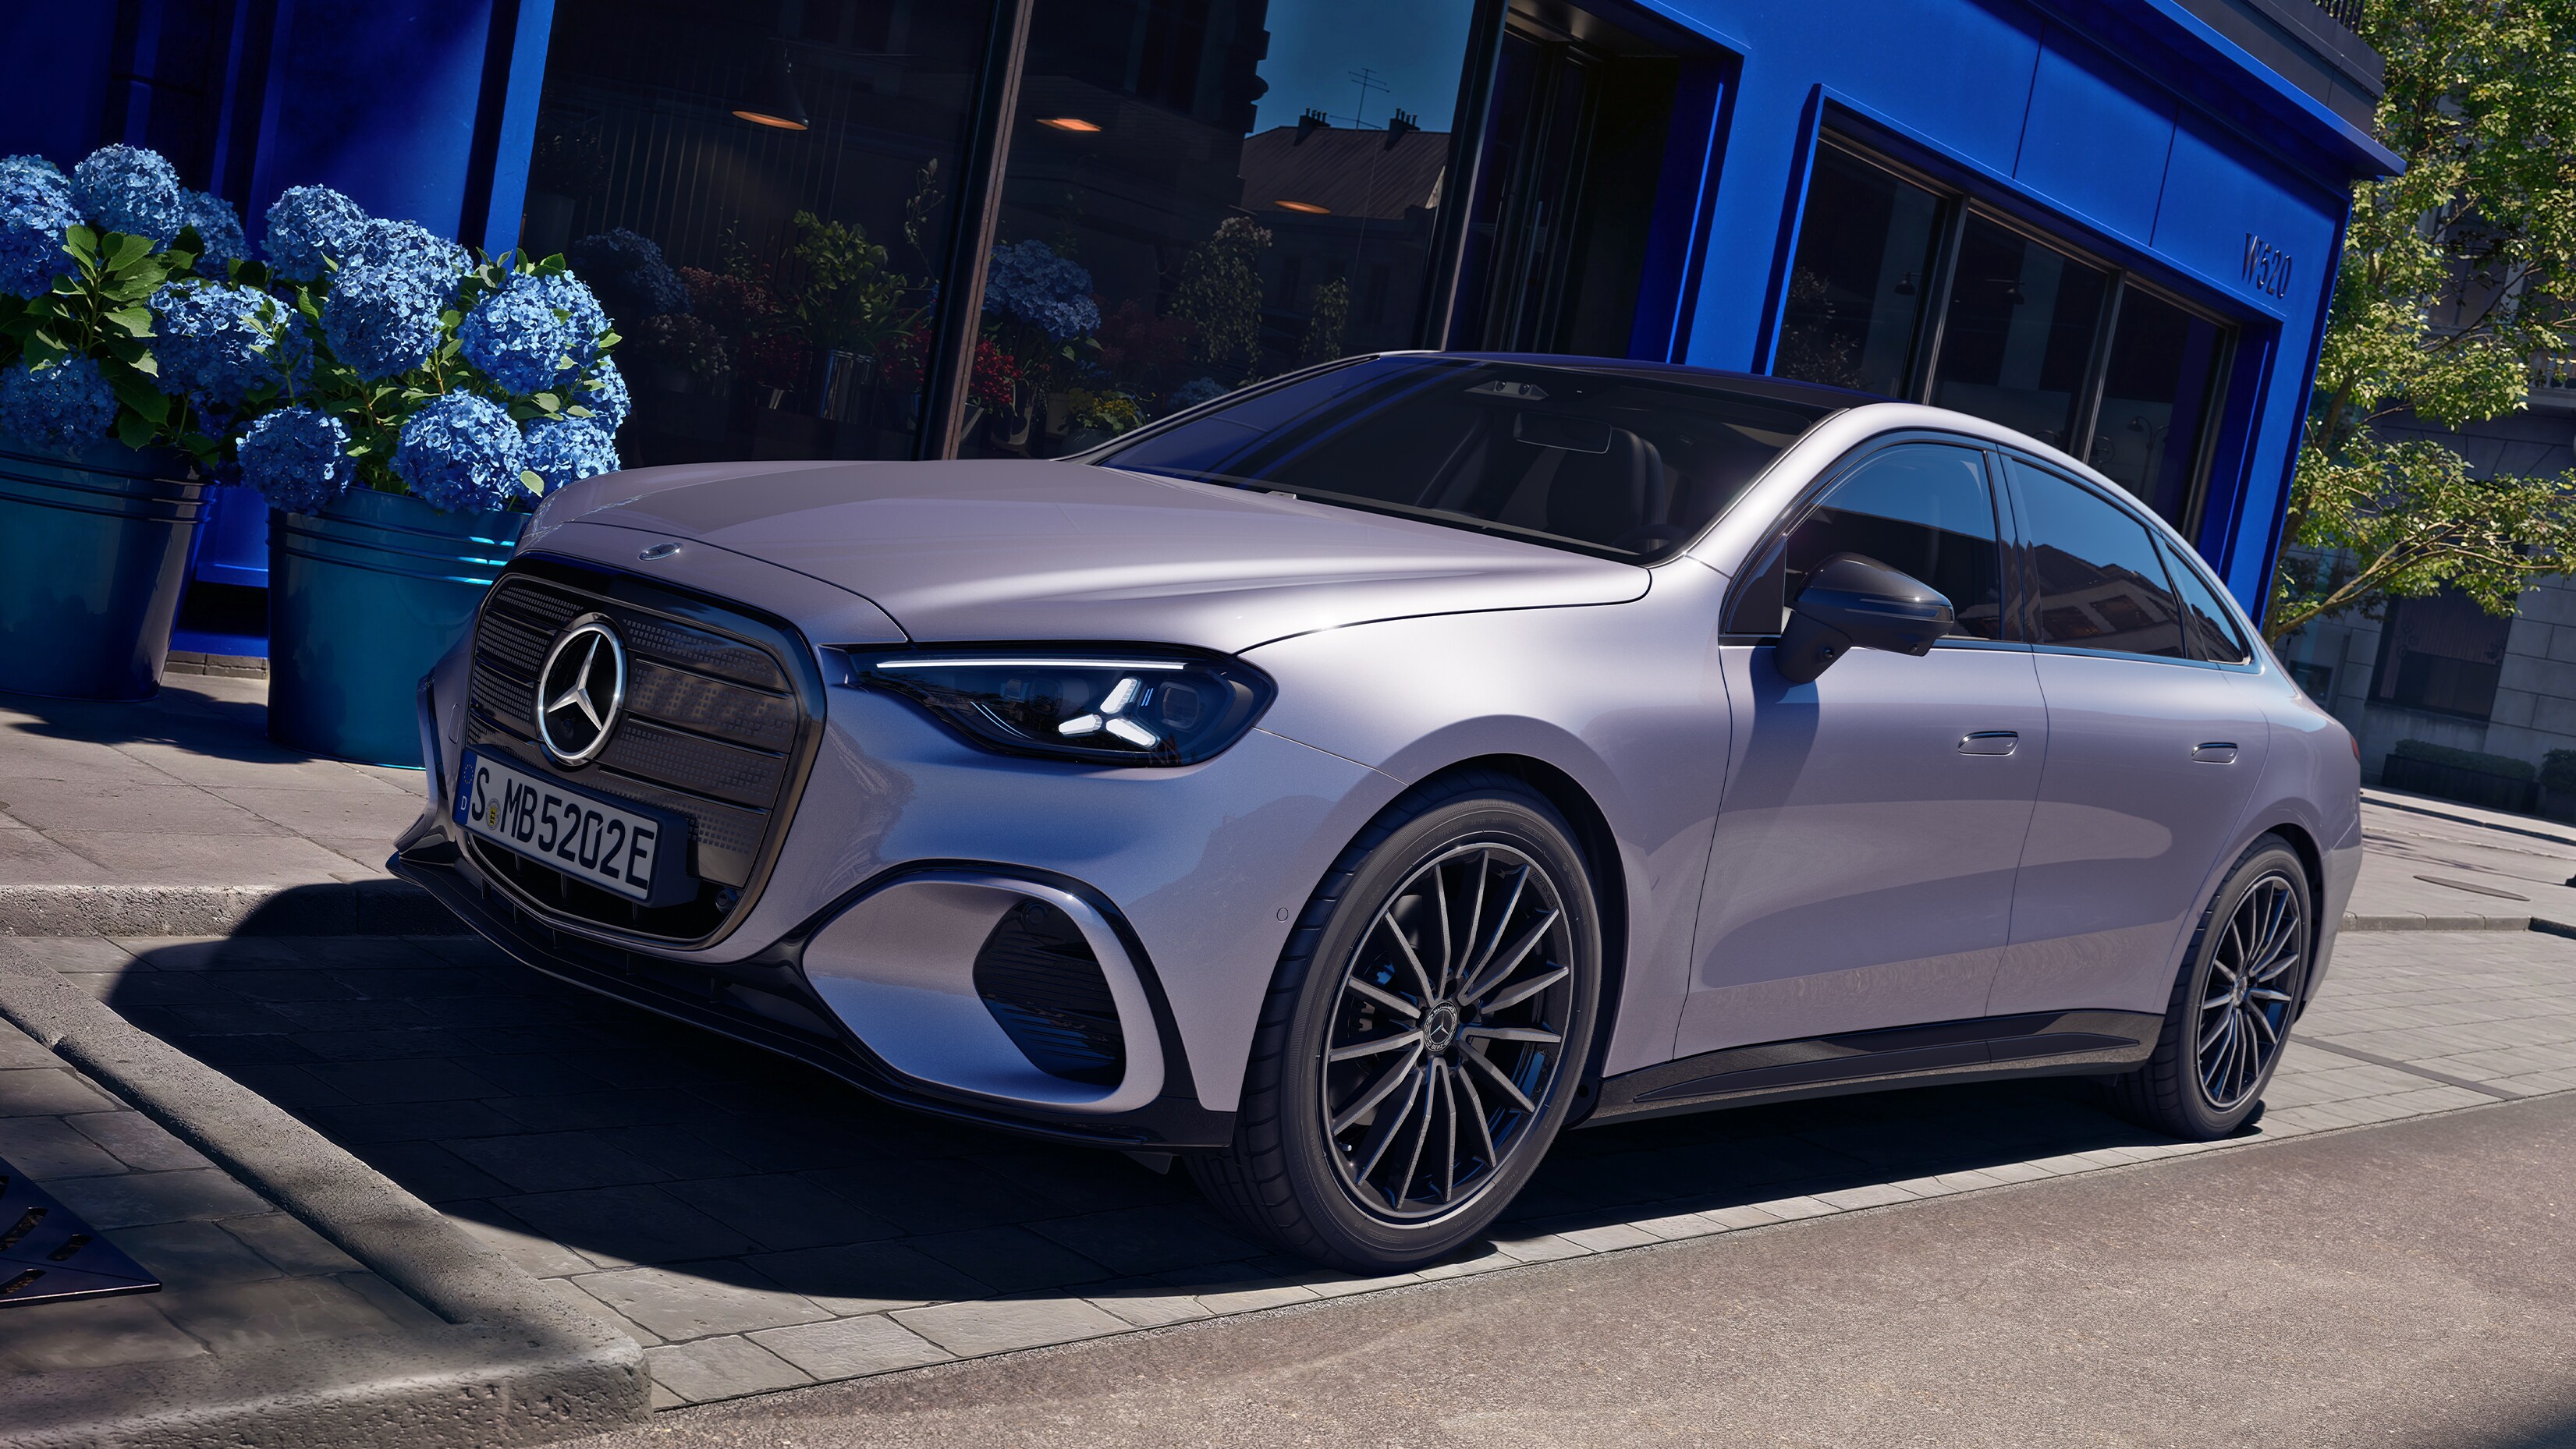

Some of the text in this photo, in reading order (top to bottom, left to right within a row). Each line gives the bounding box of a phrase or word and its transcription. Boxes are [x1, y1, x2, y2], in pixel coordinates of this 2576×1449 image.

[2241, 231, 2292, 299] W520
[460, 795, 467, 810] D
[471, 767, 490, 821] S
